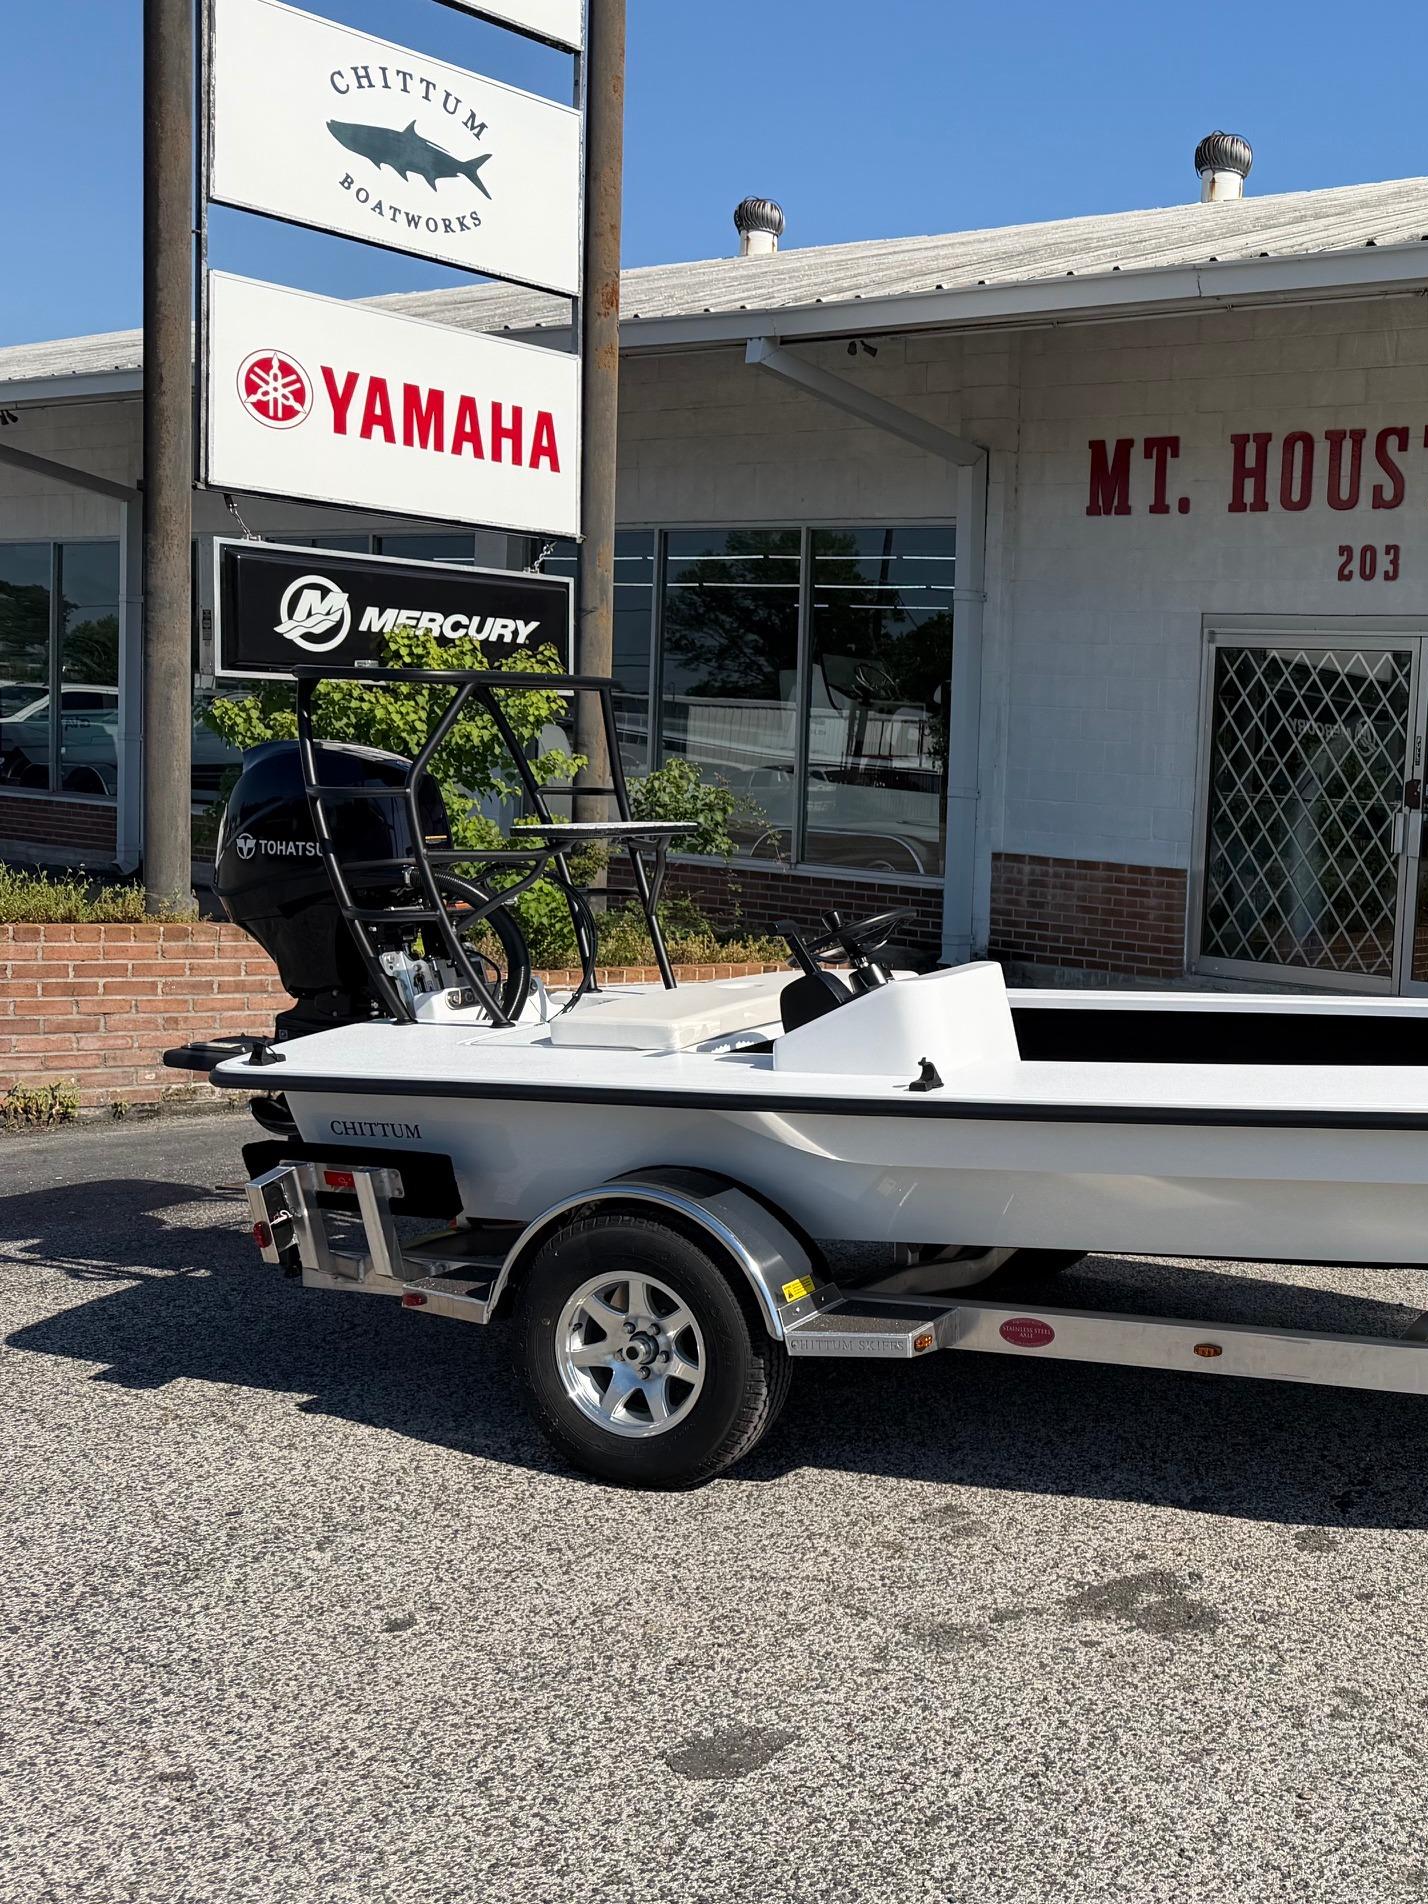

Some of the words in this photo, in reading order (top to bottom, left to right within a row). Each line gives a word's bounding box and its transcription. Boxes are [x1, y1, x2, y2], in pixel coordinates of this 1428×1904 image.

[328, 64, 488, 141] CHITTUM
[338, 172, 483, 235] BOATWORKS
[320, 365, 561, 474] YAMAHA
[1086, 435, 1191, 515] MT.
[1337, 543, 1401, 582] 203
[358, 606, 540, 644] MERCURY
[330, 1120, 422, 1139] CHITTUM
[790, 1339, 853, 1351] CHITTUM
[858, 1340, 904, 1352] SKIFFS
